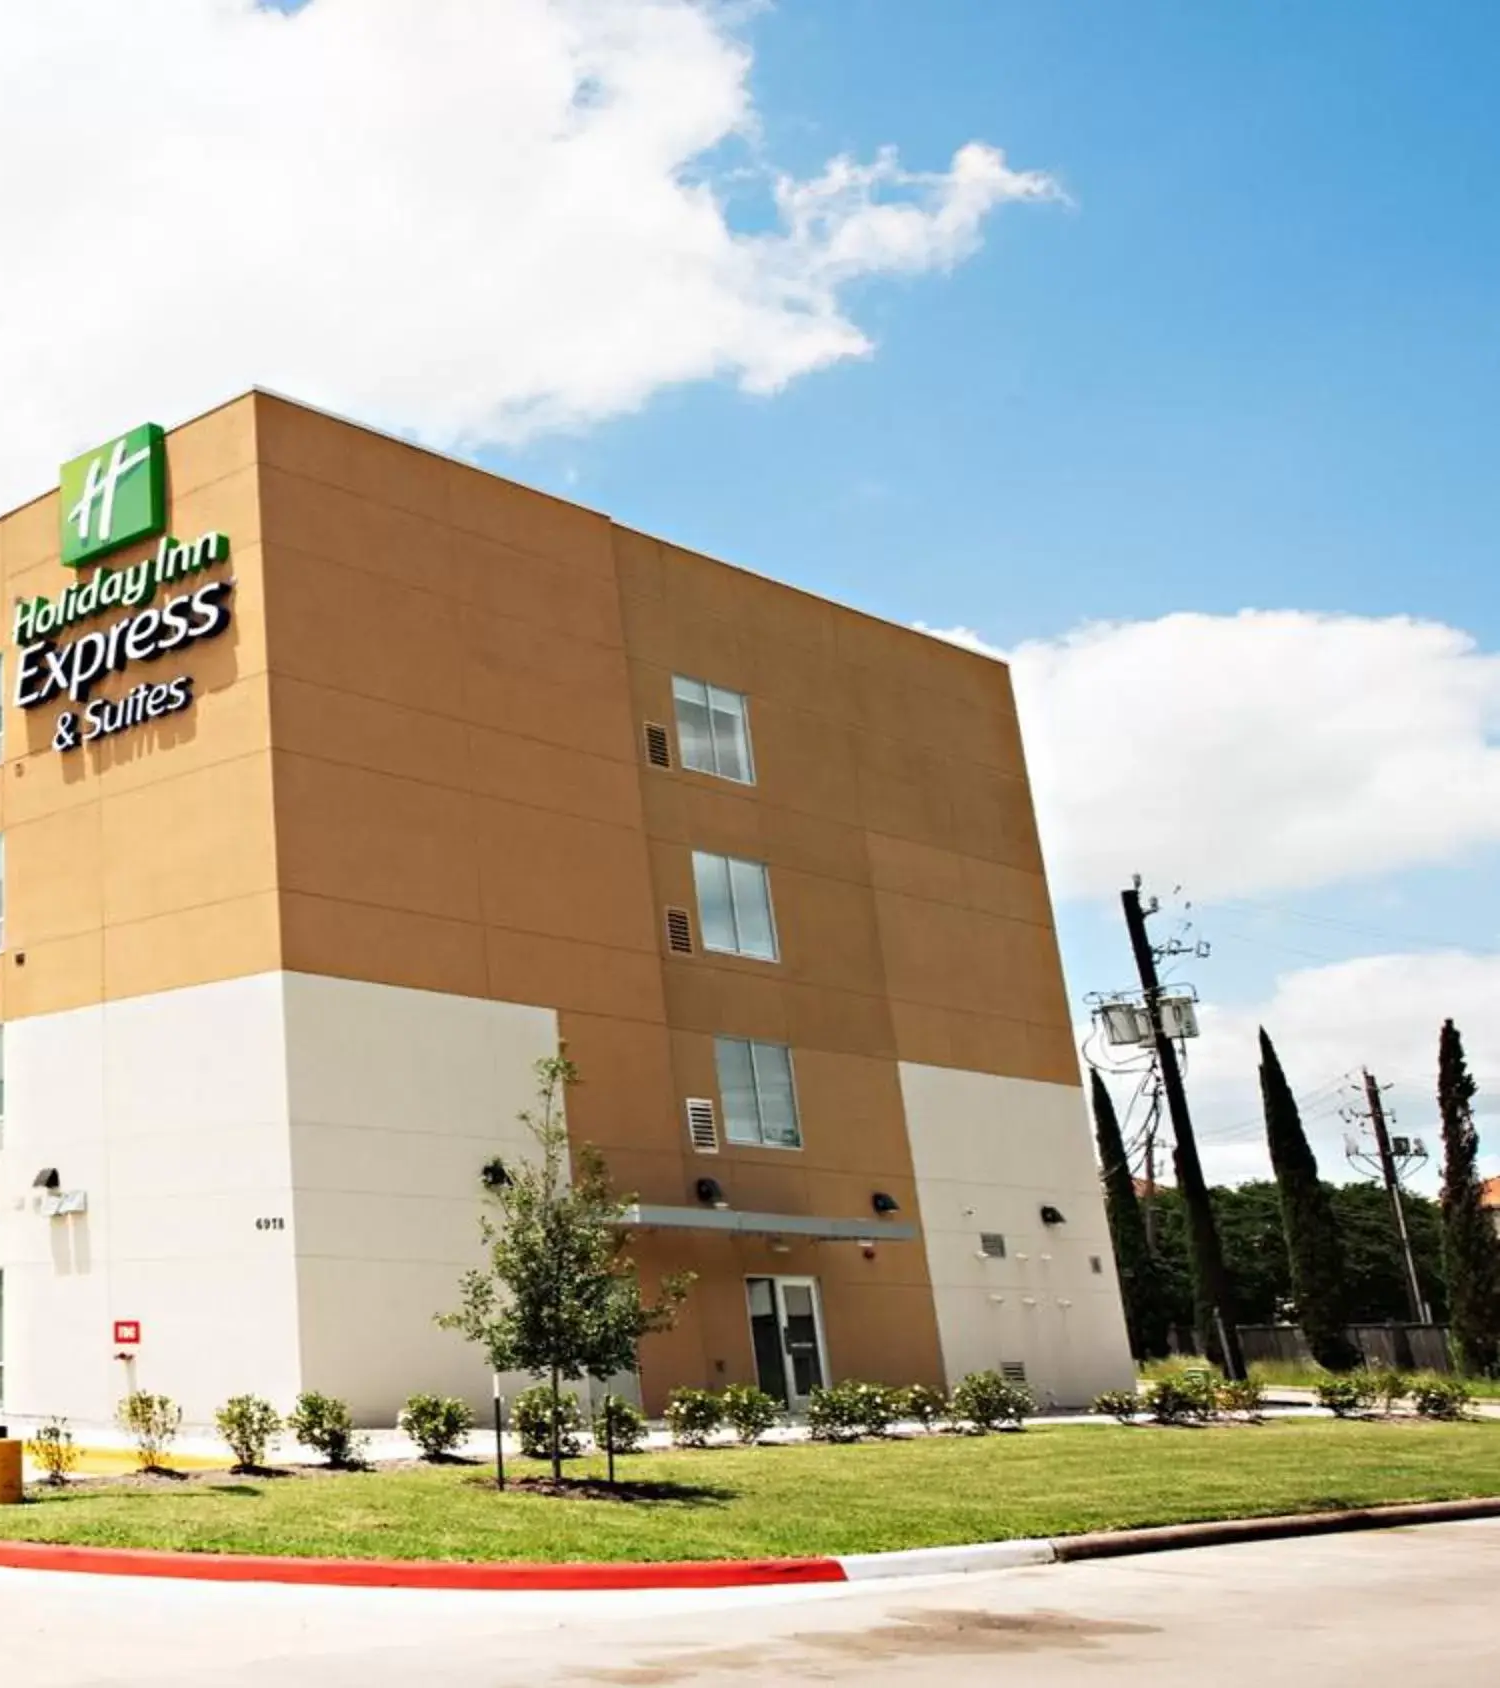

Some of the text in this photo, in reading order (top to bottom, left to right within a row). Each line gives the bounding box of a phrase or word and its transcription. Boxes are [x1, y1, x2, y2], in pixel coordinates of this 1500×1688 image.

[67, 438, 151, 541] H
[12, 531, 222, 645] Holiday Inn
[14, 581, 226, 707] Express
[52, 676, 191, 751] & Suites
